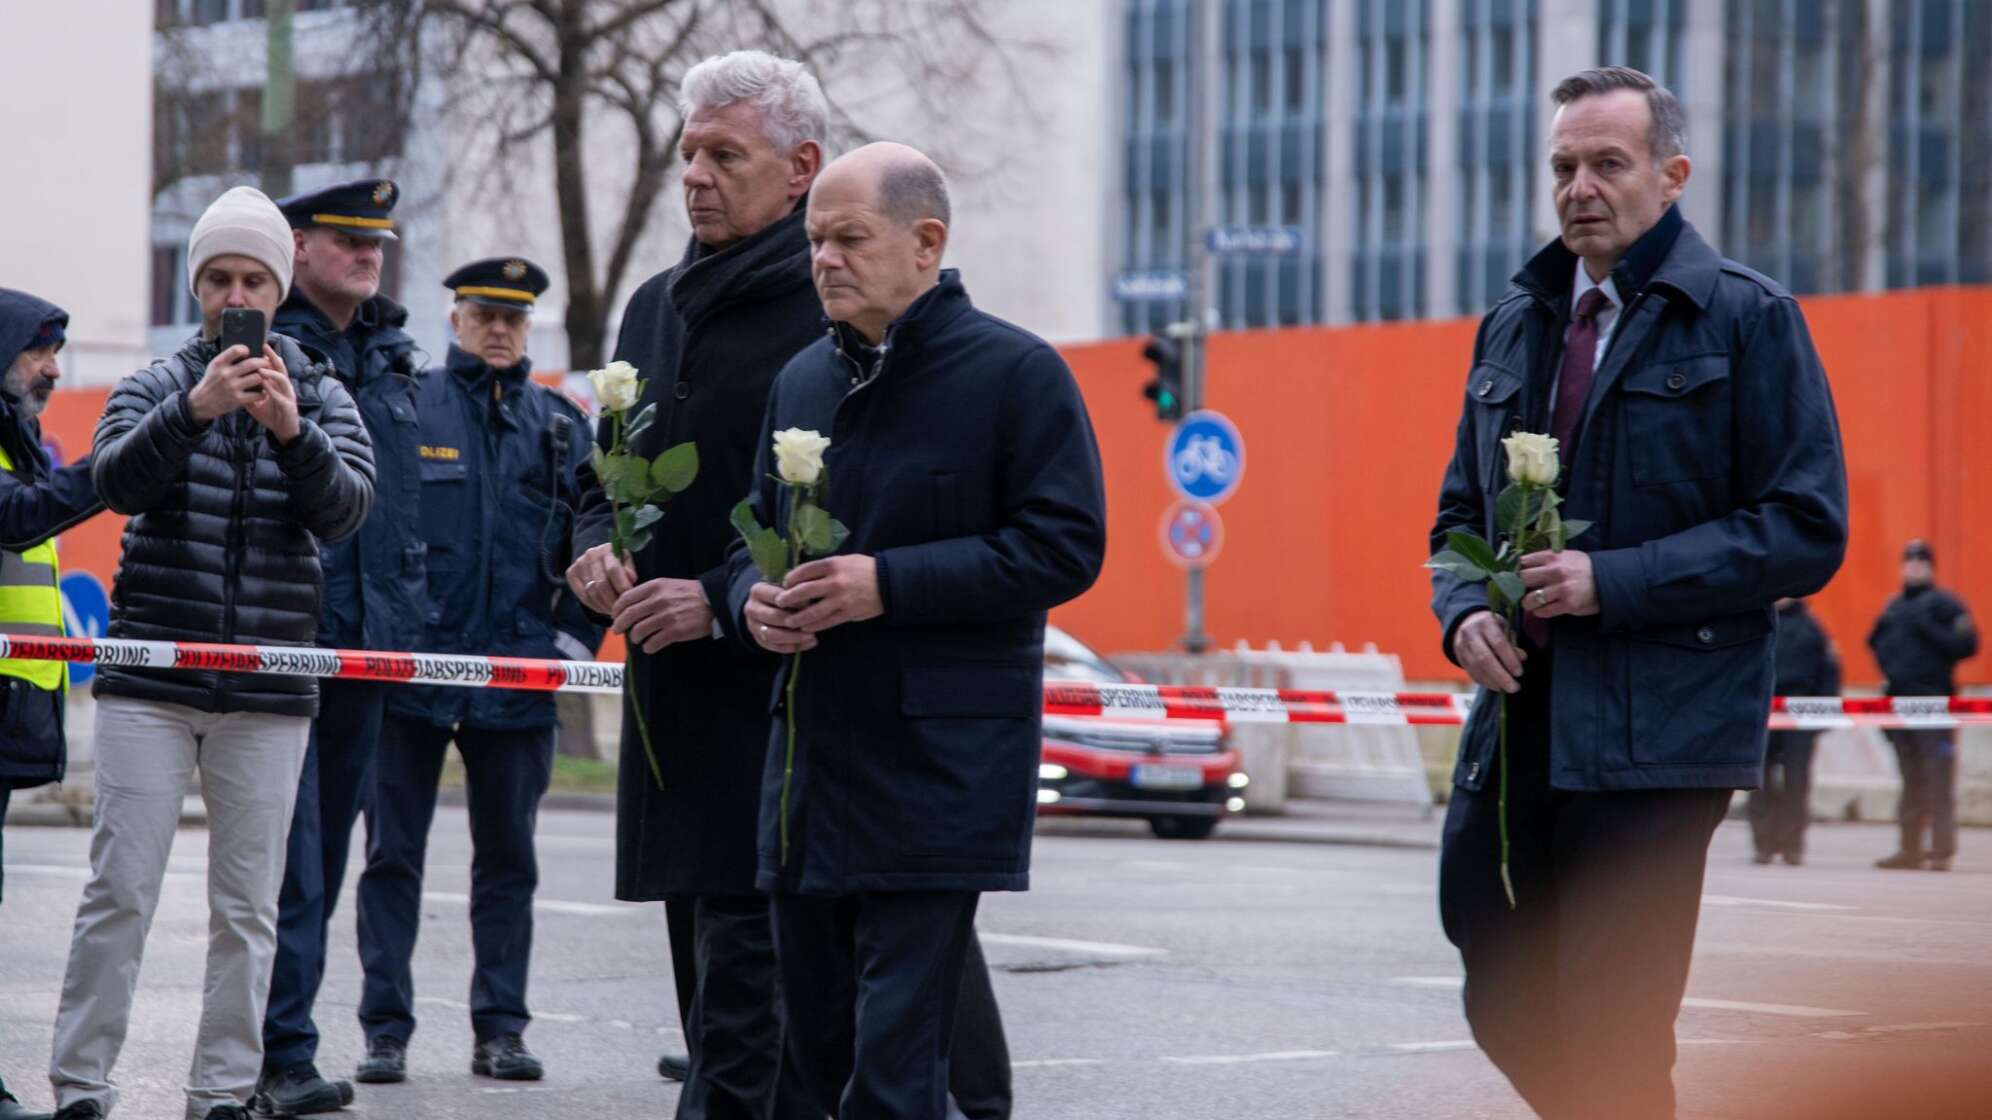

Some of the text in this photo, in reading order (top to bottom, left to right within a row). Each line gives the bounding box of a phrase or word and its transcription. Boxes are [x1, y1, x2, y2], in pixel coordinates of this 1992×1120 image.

[174, 647, 341, 673] POLIZEIABSPERRUNG
[364, 656, 528, 683] POLIZEIABSPERRUNG
[545, 663, 623, 688] POLIZEIAB
